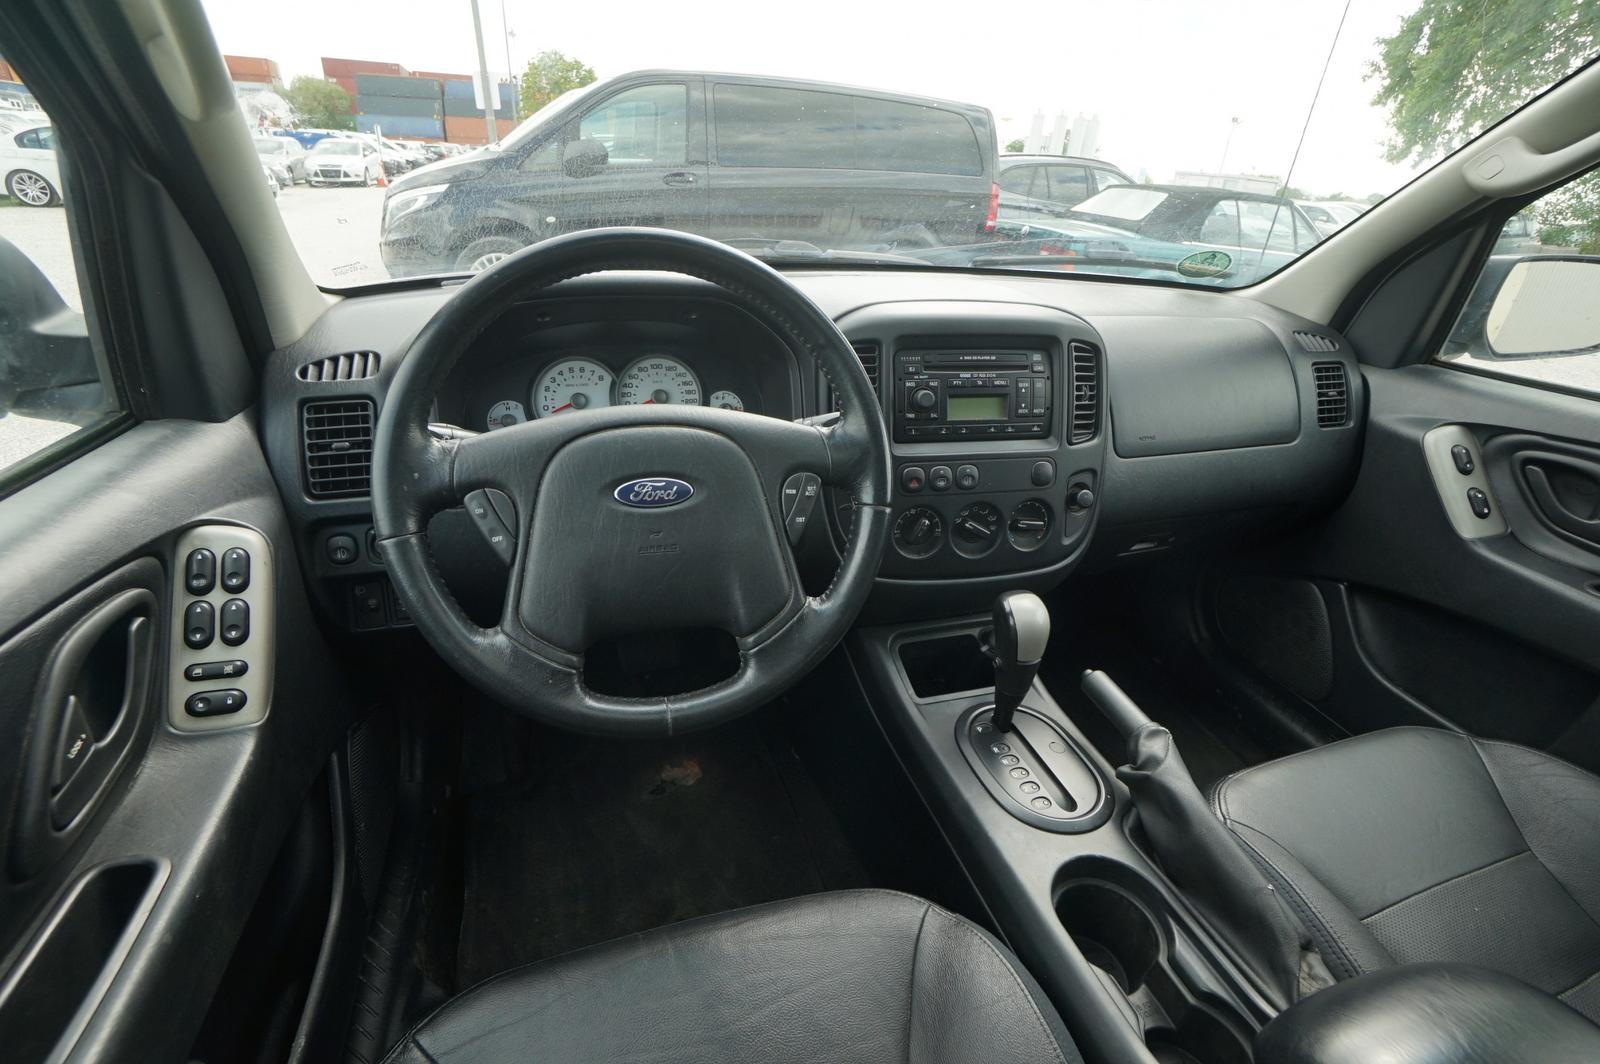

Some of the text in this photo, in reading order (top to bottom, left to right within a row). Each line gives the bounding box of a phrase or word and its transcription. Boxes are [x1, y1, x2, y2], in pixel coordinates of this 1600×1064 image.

[569, 366, 575, 374] 5
[580, 366, 586, 374] 6
[638, 366, 649, 374] 80
[665, 365, 677, 373] 120
[559, 370, 566, 378] 4
[599, 374, 605, 382] 8
[628, 373, 639, 381] 60
[623, 382, 634, 390] 40
[682, 380, 693, 388] 160
[621, 391, 632, 399] 20
[542, 404, 550, 412] 0
[630, 481, 679, 502] Ford
